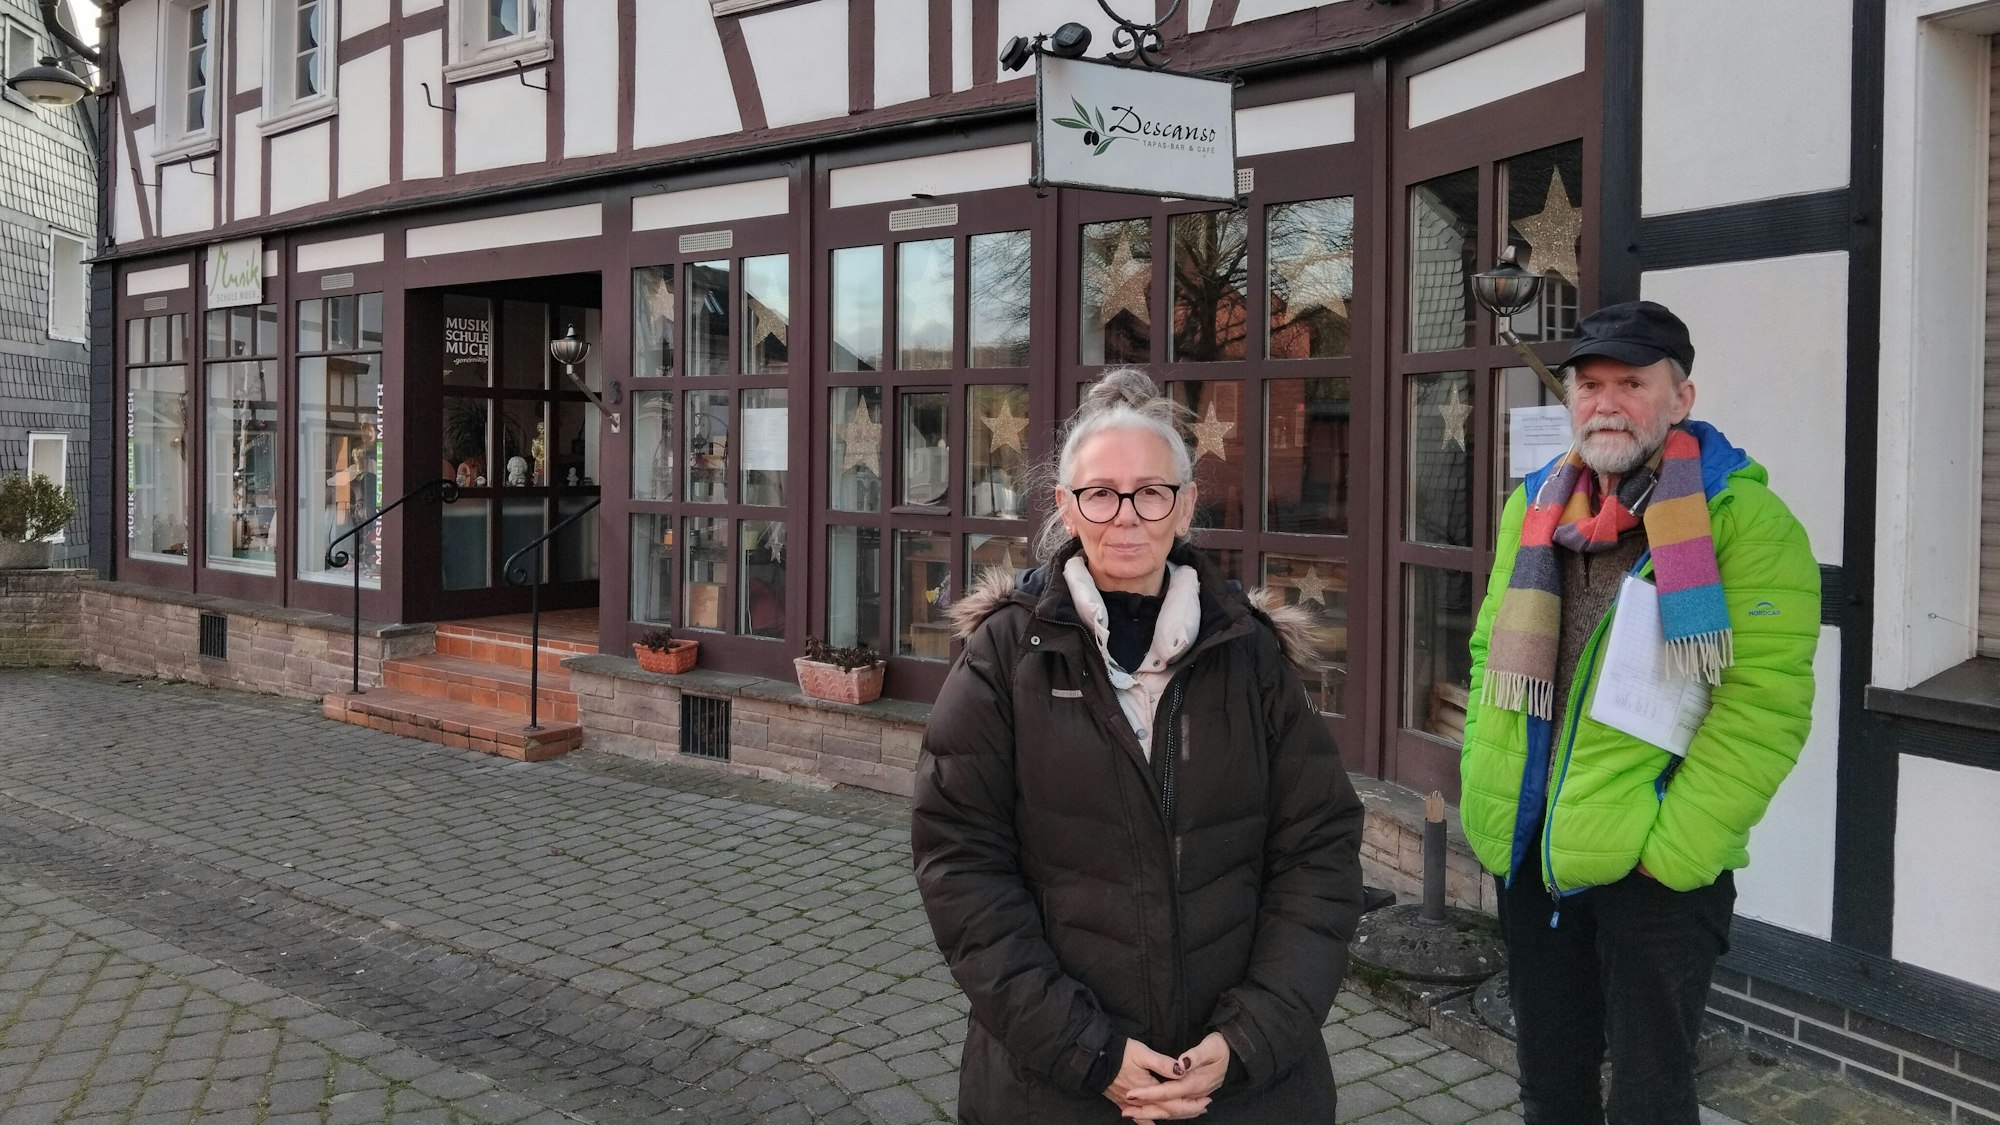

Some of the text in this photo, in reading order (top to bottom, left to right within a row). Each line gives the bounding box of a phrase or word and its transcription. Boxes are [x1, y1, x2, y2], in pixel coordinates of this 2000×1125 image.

[1109, 106, 1216, 143] Descanso
[1143, 140, 1185, 151] TAPAS-BAR
[209, 244, 261, 296] Musik
[446, 316, 489, 332] MUSIK
[445, 329, 489, 343] SCHULE
[445, 341, 488, 356] MUCH
